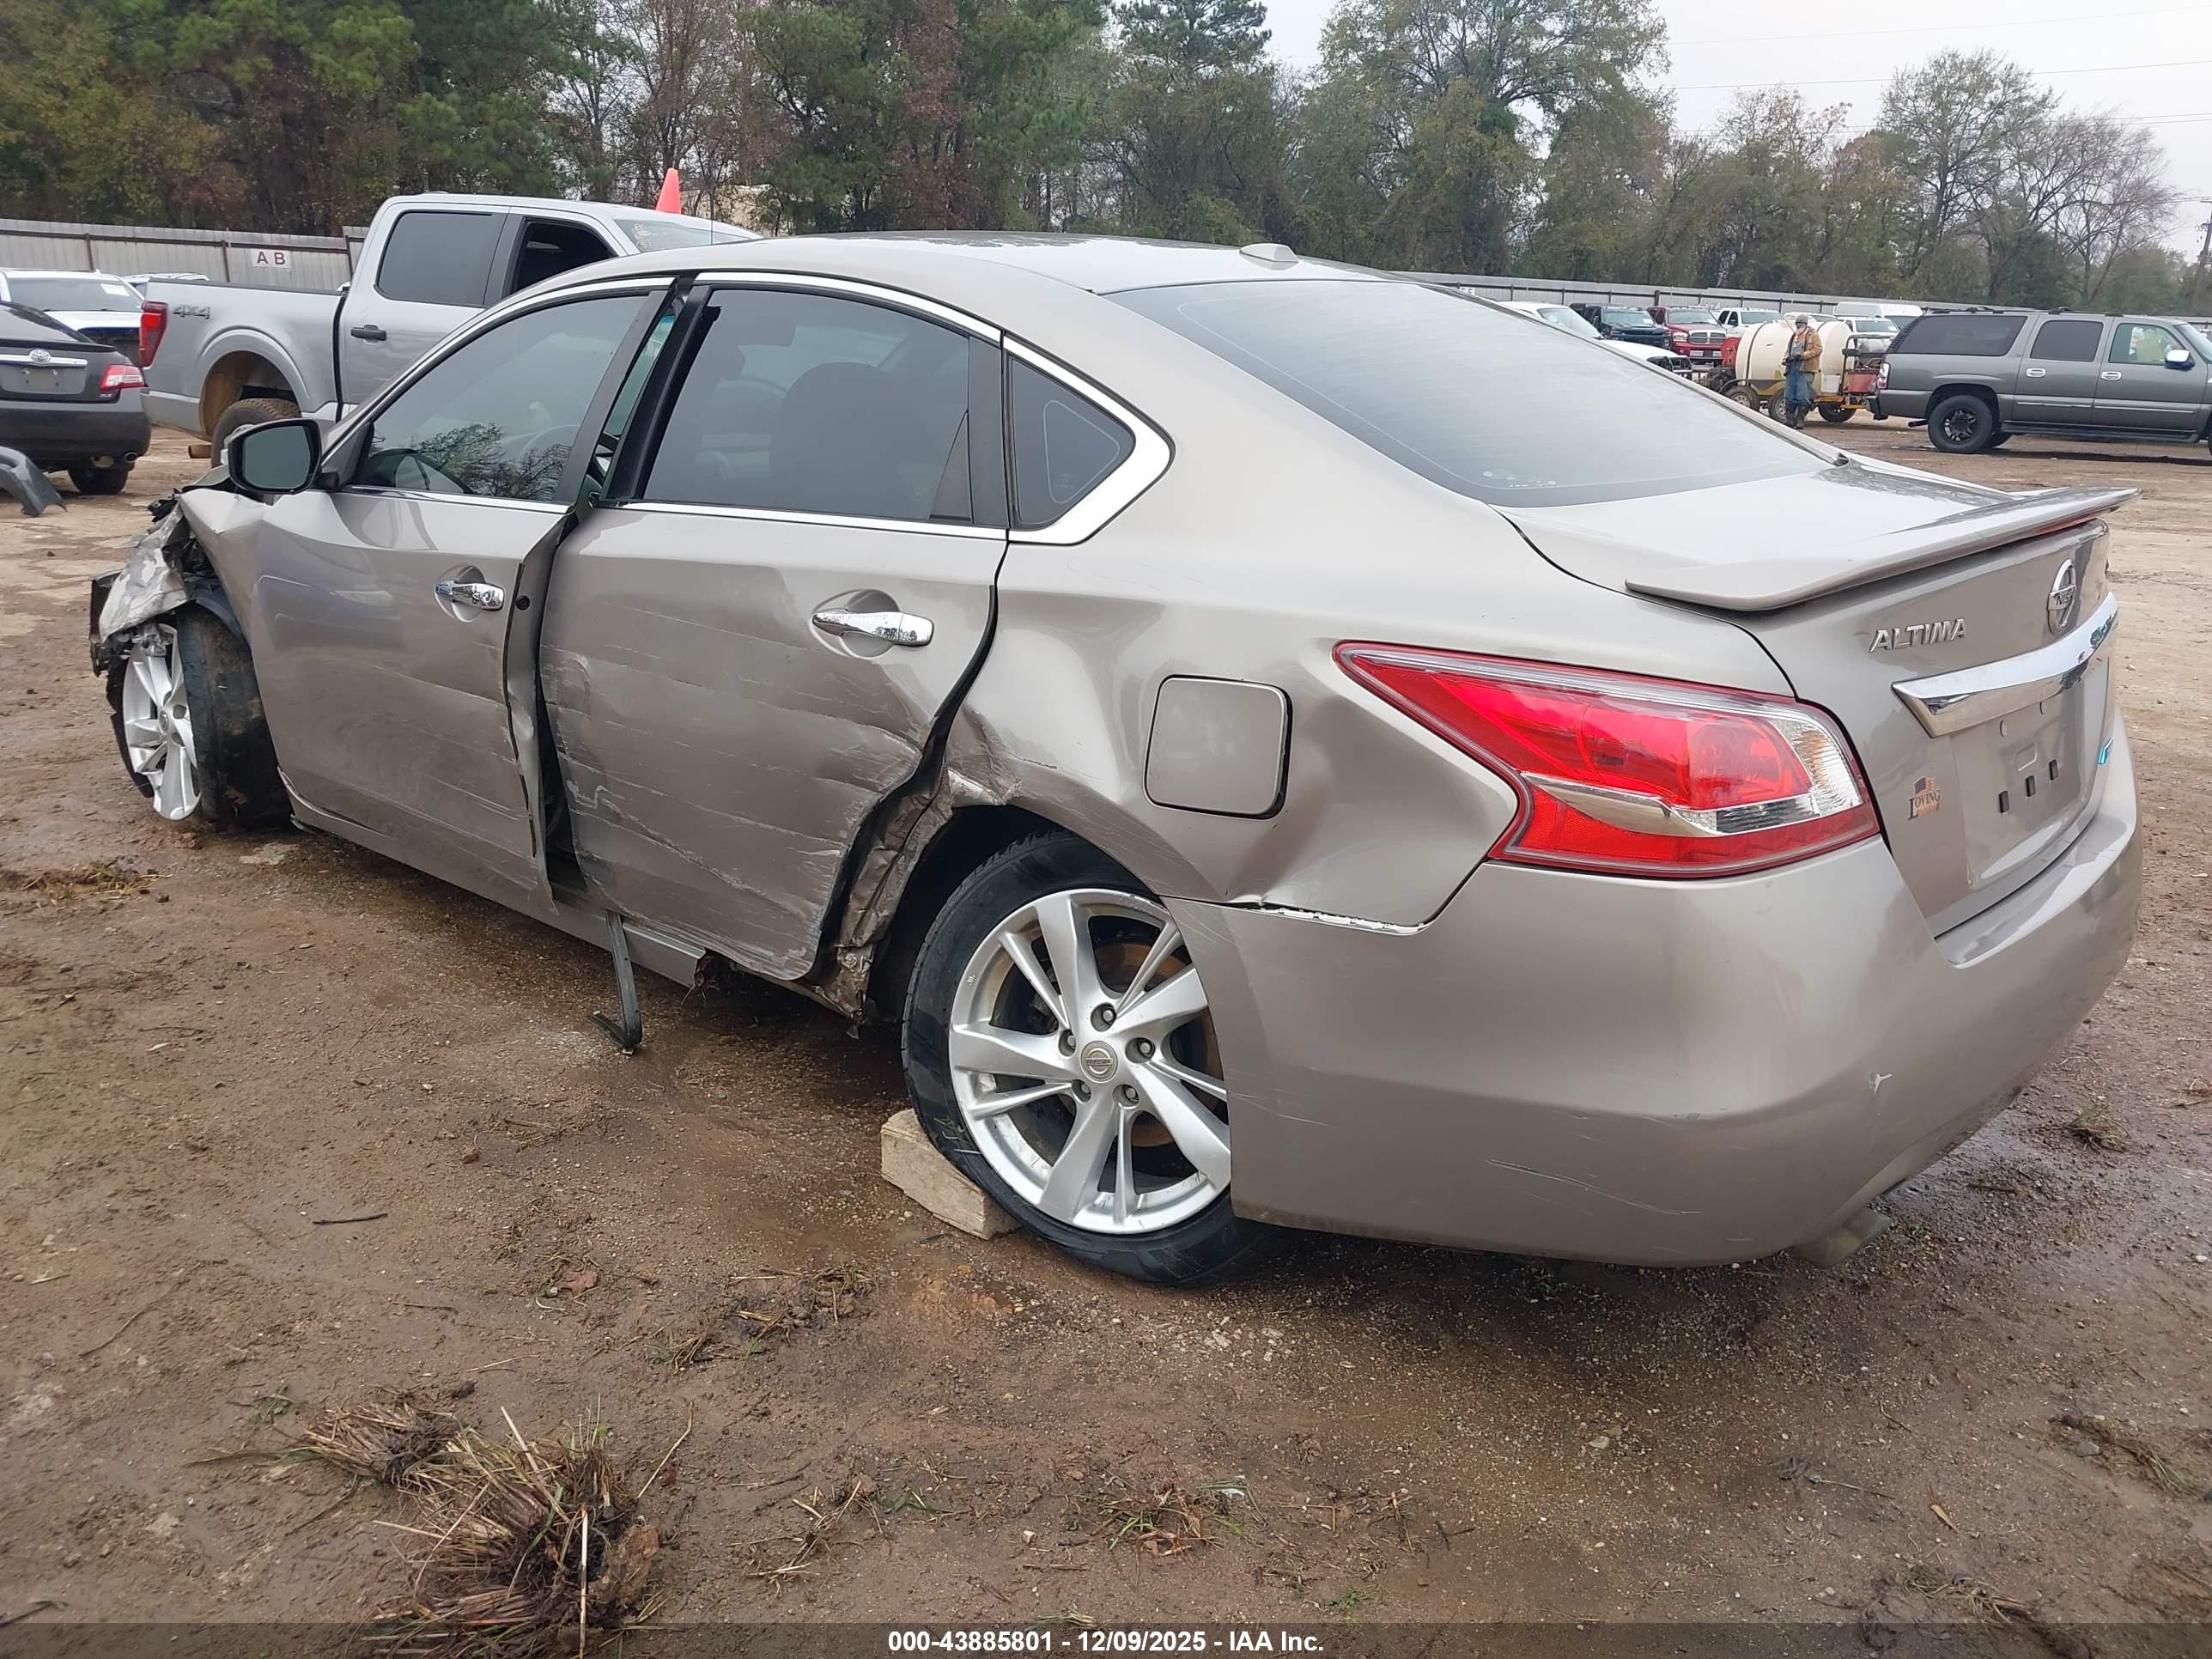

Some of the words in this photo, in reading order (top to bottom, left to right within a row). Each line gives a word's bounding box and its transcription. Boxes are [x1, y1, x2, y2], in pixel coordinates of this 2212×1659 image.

[257, 251, 269, 264] A
[274, 252, 286, 265] B
[1869, 617, 1966, 653] ALTIMA
